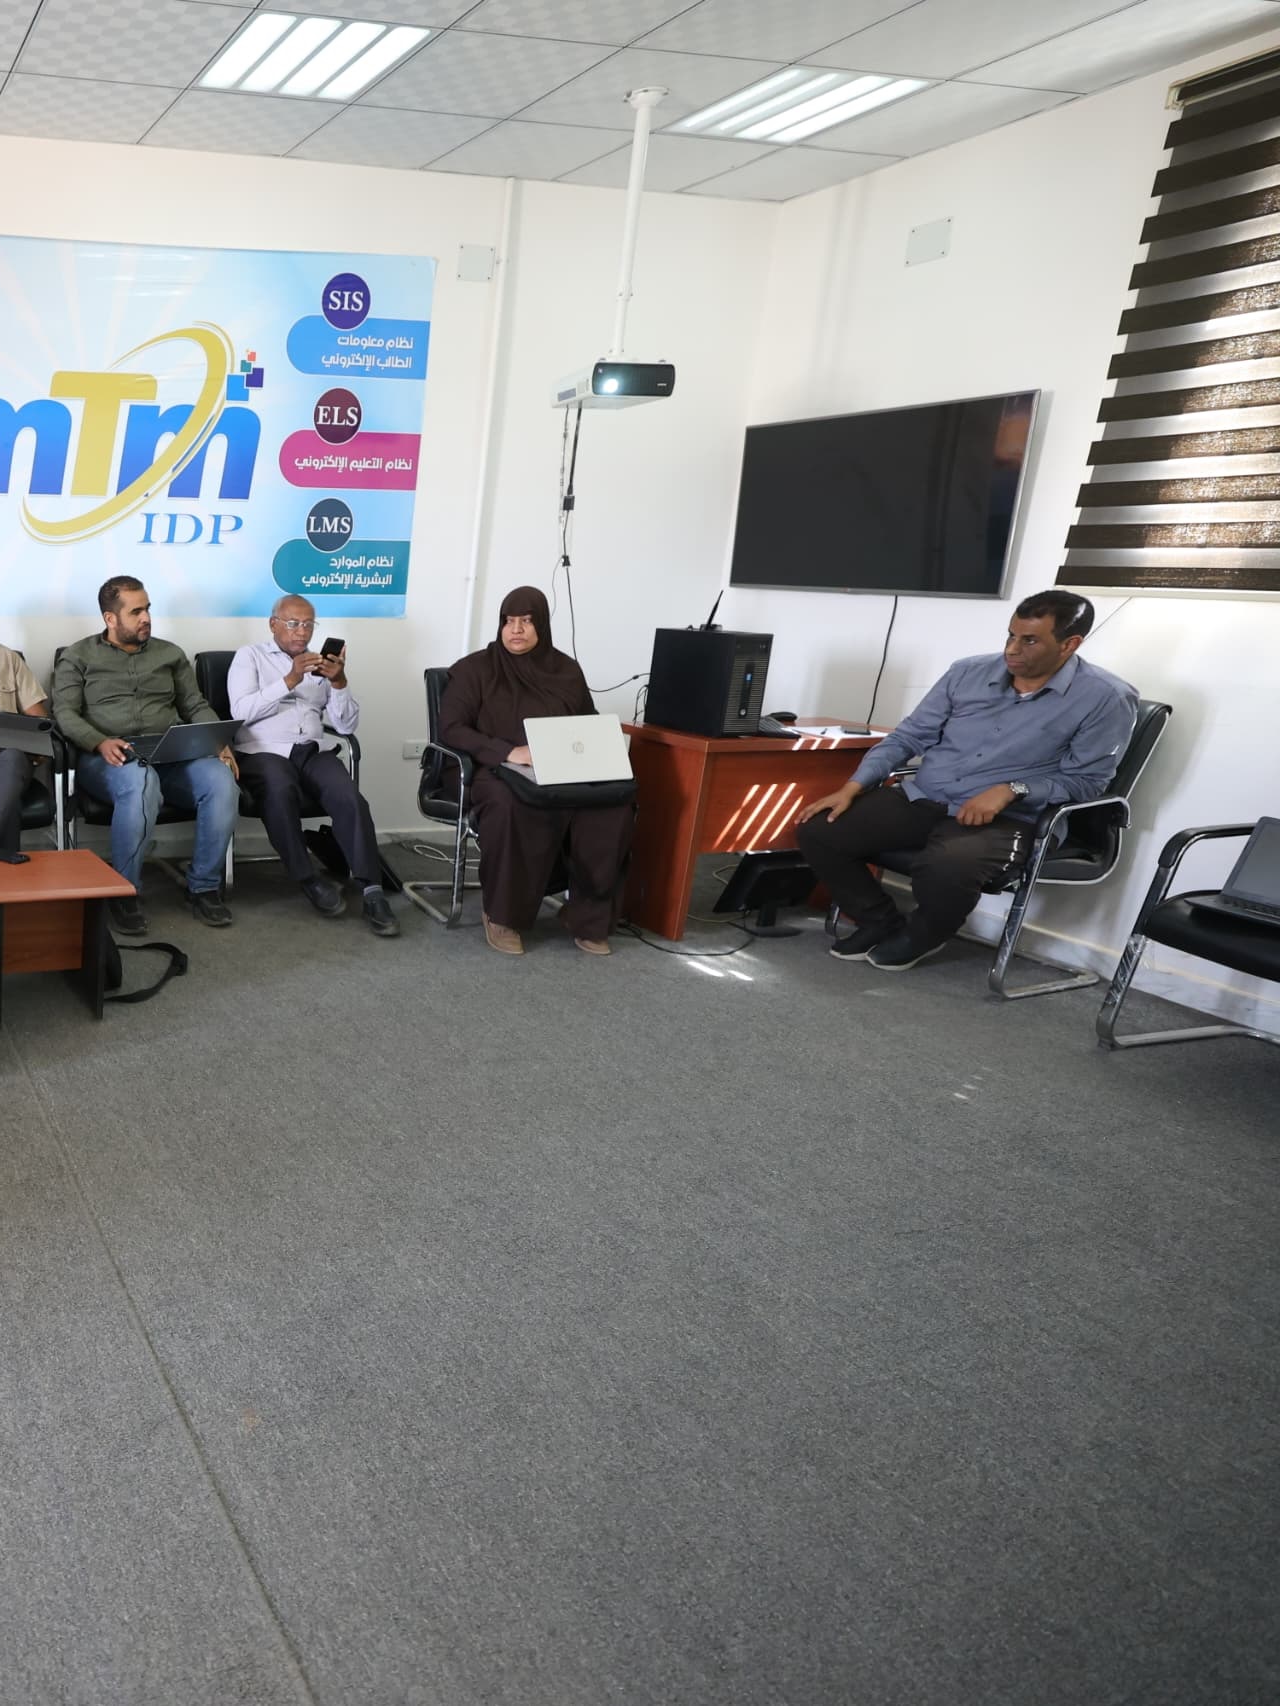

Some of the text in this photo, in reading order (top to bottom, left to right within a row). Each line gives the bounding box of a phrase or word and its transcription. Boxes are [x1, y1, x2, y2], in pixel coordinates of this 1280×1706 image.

[328, 290, 364, 312] SIS
[337, 334, 414, 351] نظام معلومات
[321, 352, 412, 371] الطالب الإلكتروني
[316, 405, 359, 427] ELS
[294, 454, 413, 473] نظام التعليم الإلكتروني
[137, 512, 244, 545] IDP
[307, 515, 351, 534] LMS
[329, 555, 394, 570] نظام الموارد
[301, 572, 393, 590] البشرية الإلكتروني
